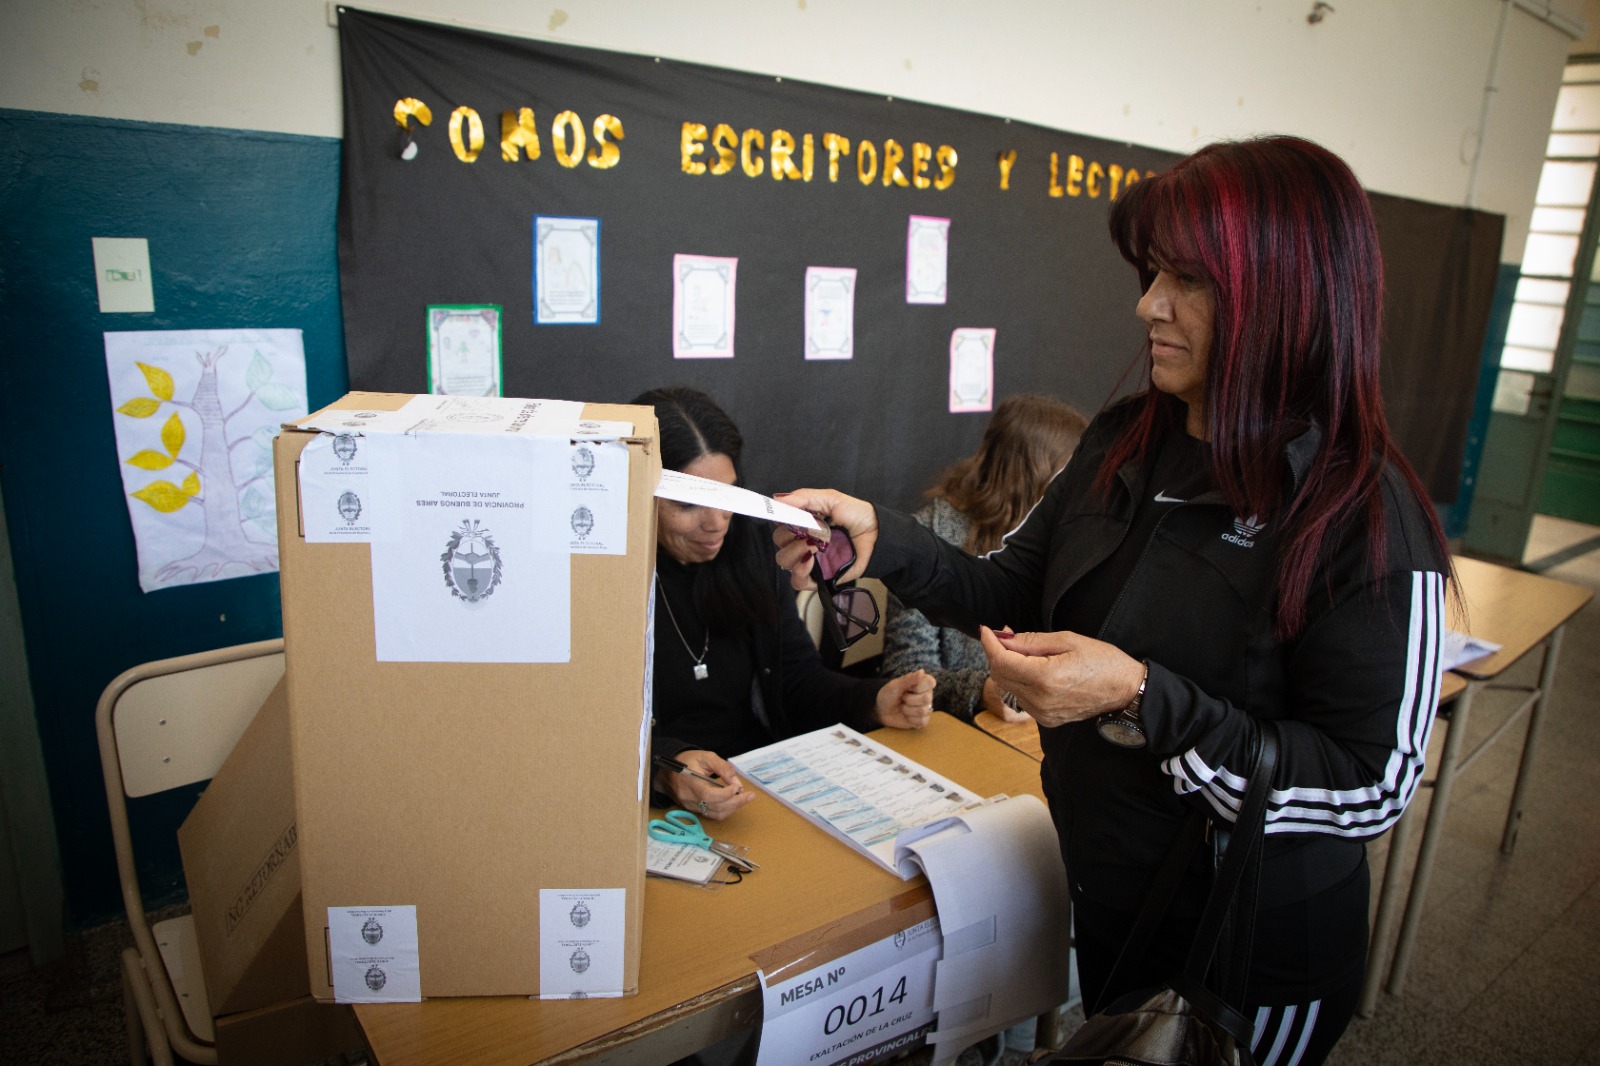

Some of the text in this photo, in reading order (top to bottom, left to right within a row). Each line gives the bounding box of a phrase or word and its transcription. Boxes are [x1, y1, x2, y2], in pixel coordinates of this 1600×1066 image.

[681, 121, 958, 190] ESCRITORES
[997, 149, 1017, 190] Y
[1048, 152, 1157, 201] LECTO
[1221, 532, 1255, 548] adidas
[780, 977, 825, 1006] MESA
[824, 975, 907, 1036] 0014
[809, 1031, 864, 1062] EXALTACIÓN
[865, 1026, 877, 1037] DE
[878, 1022, 890, 1031] LA
[891, 1012, 913, 1027] CRUZ
